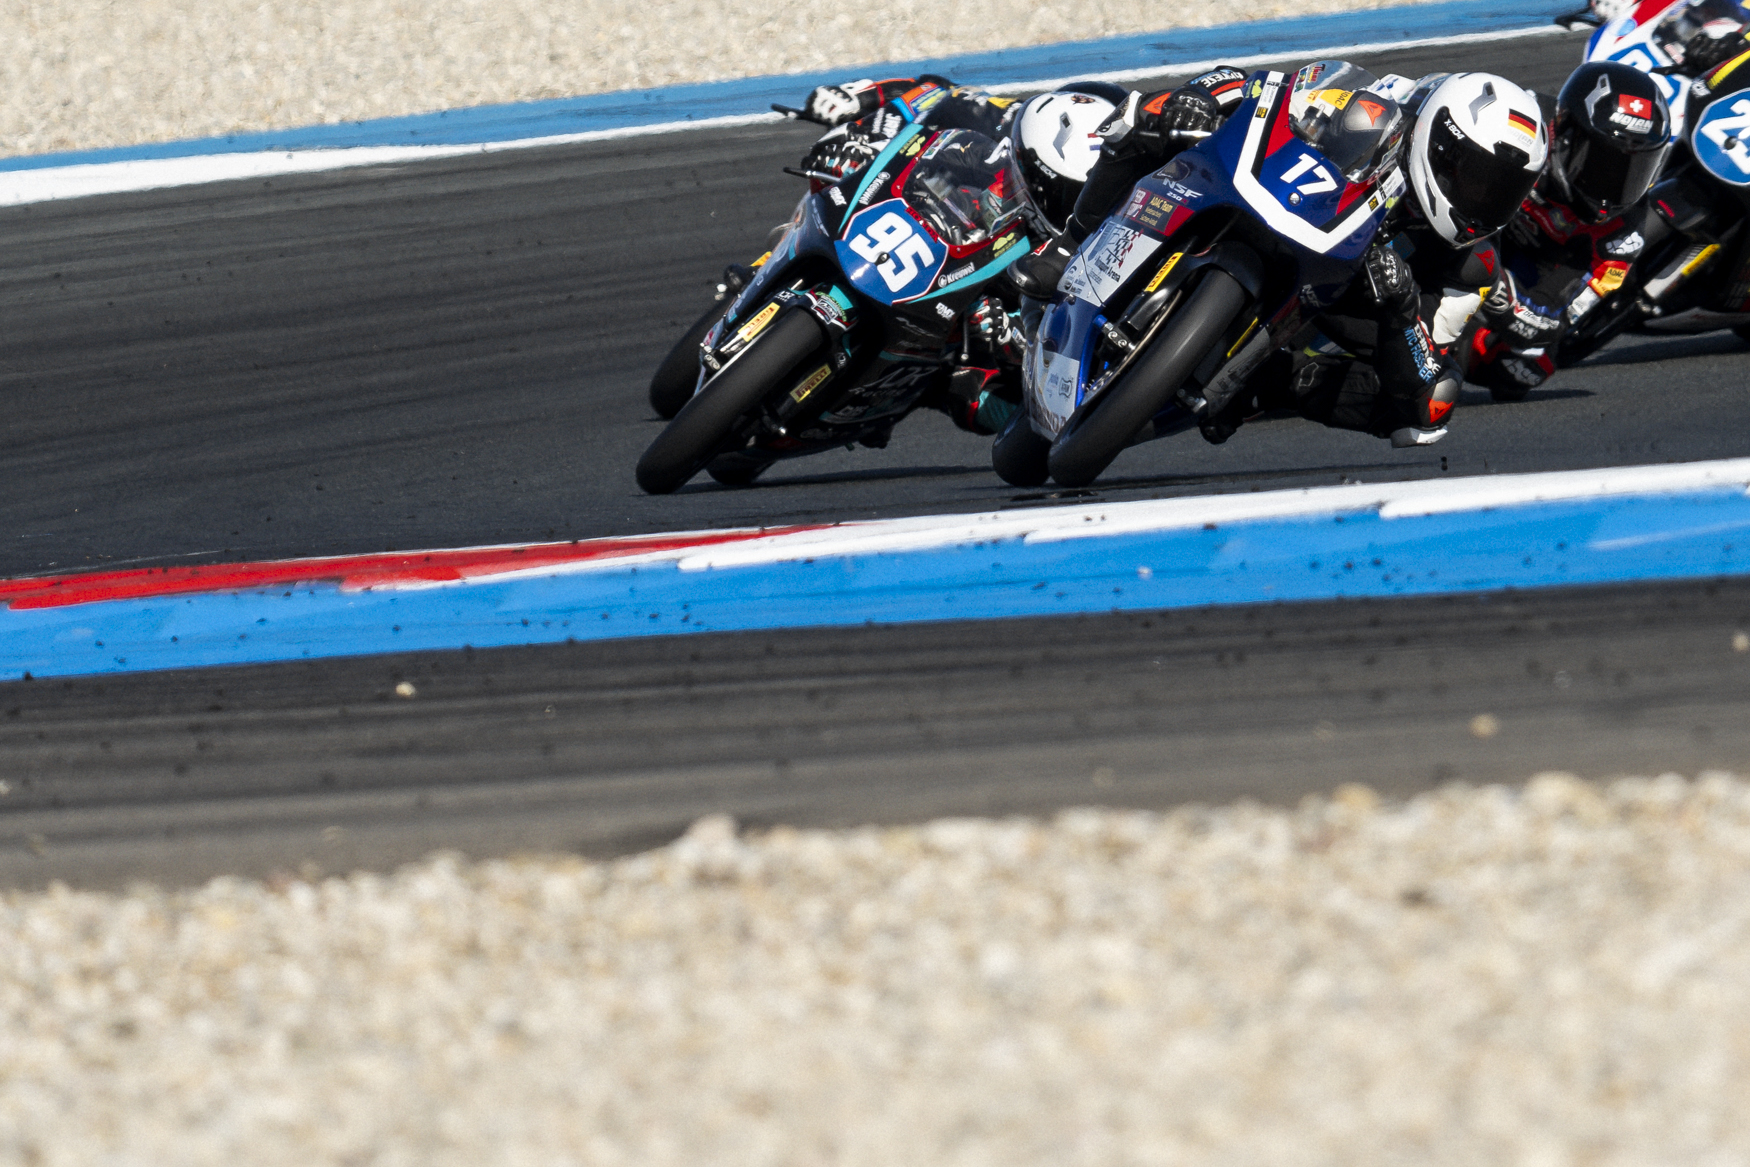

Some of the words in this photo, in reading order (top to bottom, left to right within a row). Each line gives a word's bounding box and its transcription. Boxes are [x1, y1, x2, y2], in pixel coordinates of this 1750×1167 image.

[1609, 111, 1653, 134] NOLAN
[1162, 177, 1204, 199] NSF
[1280, 152, 1338, 195] 17
[848, 211, 935, 293] 95
